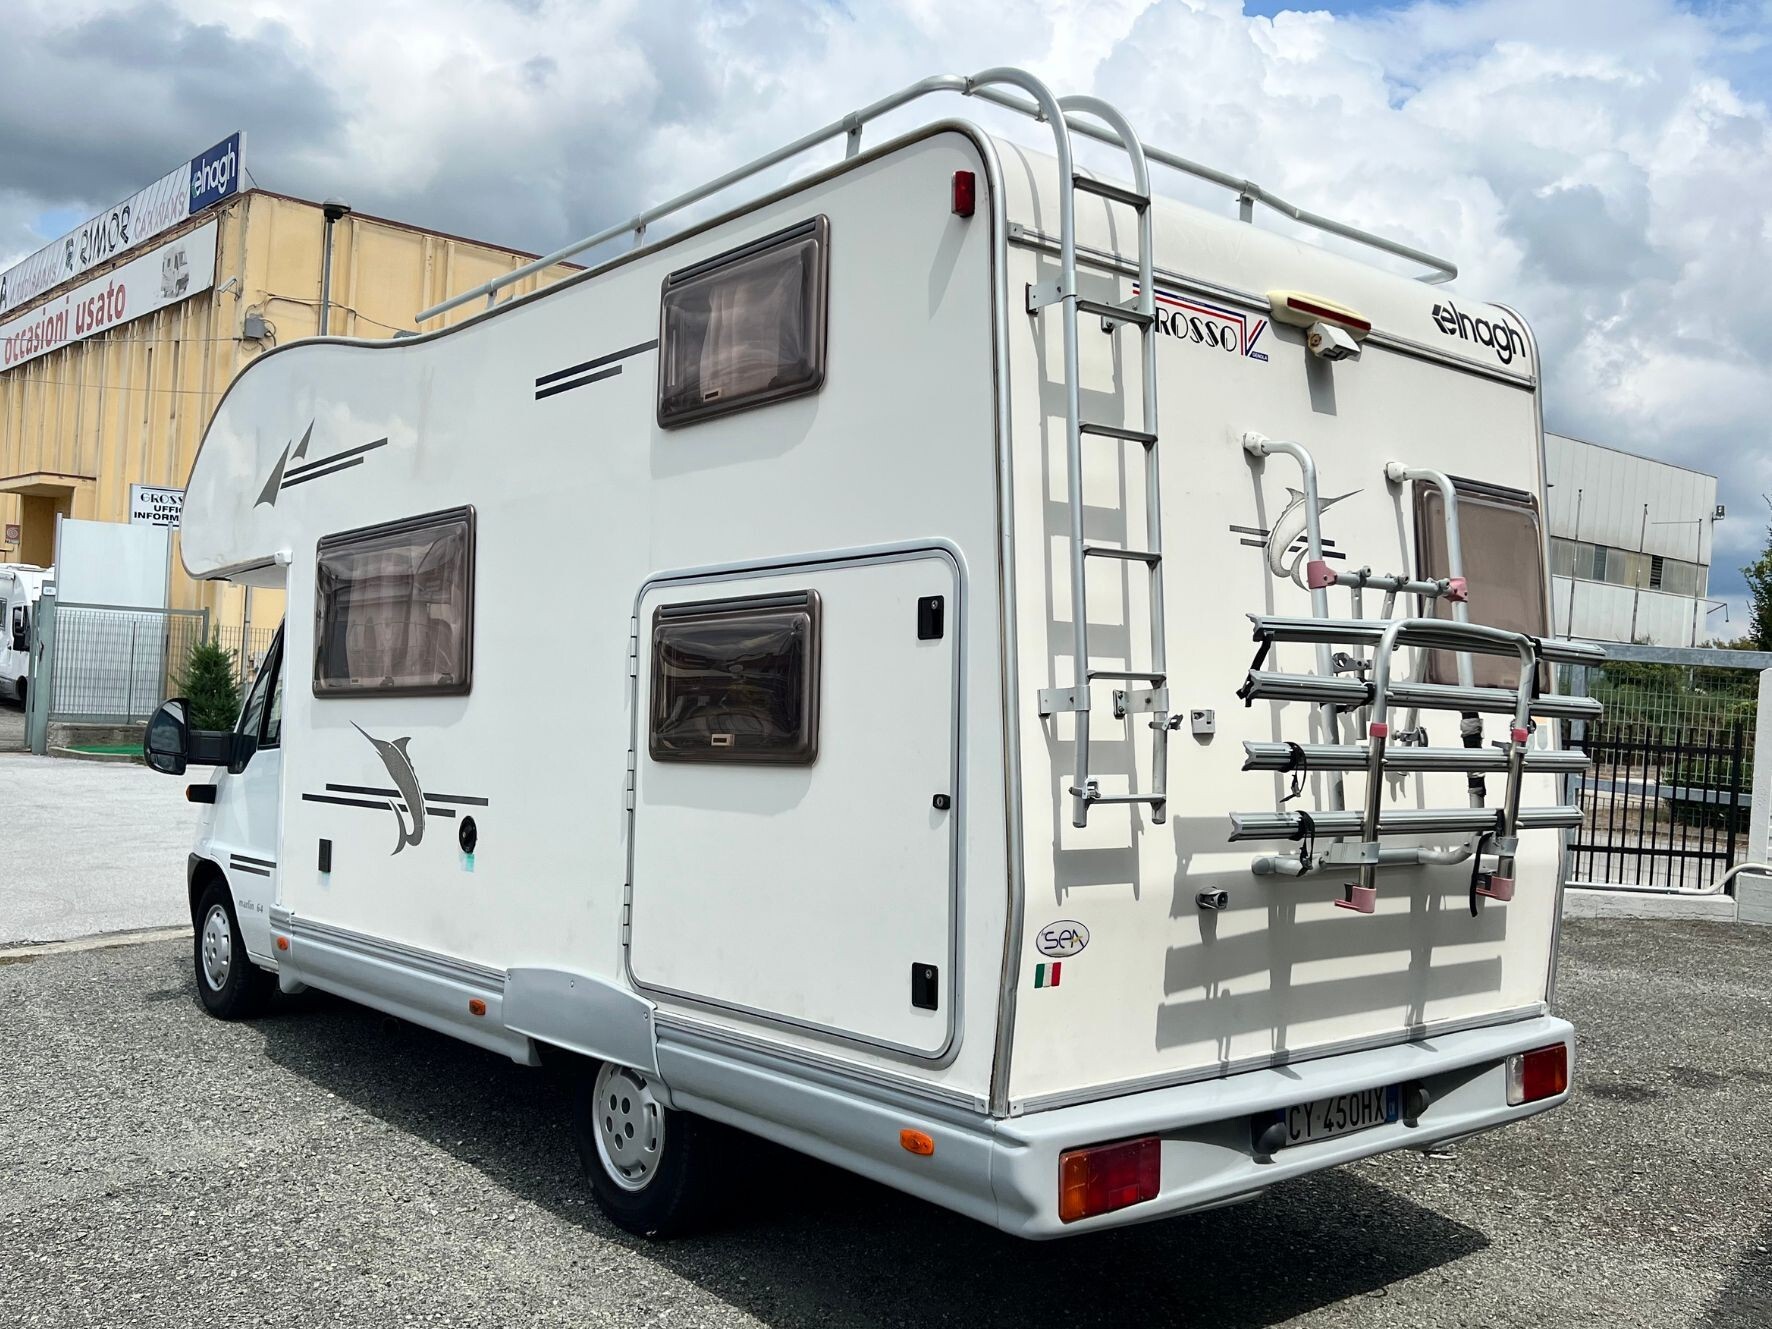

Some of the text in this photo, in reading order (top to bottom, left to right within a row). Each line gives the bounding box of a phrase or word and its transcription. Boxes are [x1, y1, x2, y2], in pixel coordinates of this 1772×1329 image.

[192, 143, 235, 197] elnagh
[79, 205, 131, 265] RIMOR
[4, 279, 126, 364] occasioni usato
[1154, 307, 1238, 352] ROSSO
[1434, 299, 1526, 365] elnagh
